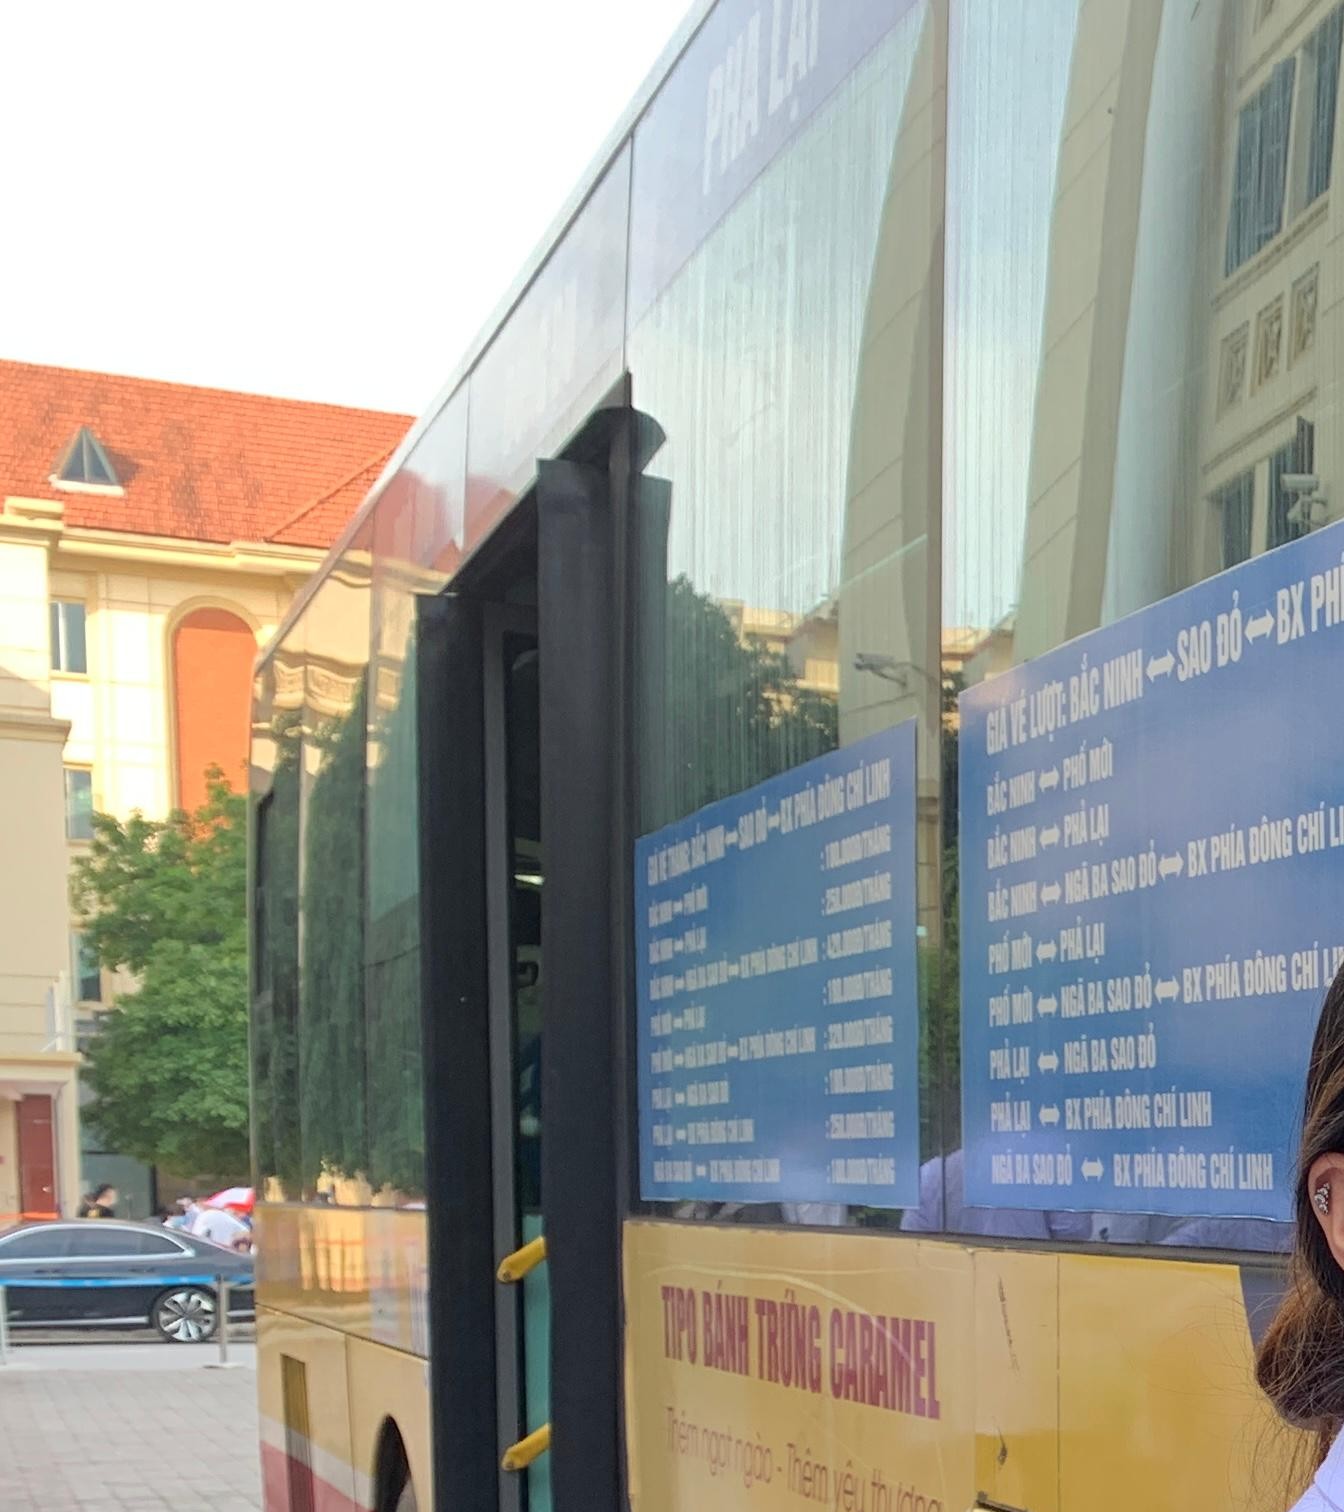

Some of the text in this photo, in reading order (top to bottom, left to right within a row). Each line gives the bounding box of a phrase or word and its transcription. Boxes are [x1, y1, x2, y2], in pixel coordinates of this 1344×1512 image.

[1103, 649, 1143, 710] NINH
[1177, 621, 1211, 681] SAO
[1216, 590, 1242, 667] ĐỎ
[1277, 582, 1304, 644] BX
[1092, 863, 1109, 898] BA
[1111, 856, 1135, 895] SAO
[1188, 840, 1207, 877] BX
[1211, 824, 1245, 872] PHÍA
[1249, 816, 1292, 864] ĐÔNG
[1297, 802, 1325, 854] CHÍ
[1087, 981, 1104, 1015] BA
[1107, 977, 1131, 1012] SAO
[1183, 967, 1203, 1004] BX
[1206, 954, 1240, 1001] PHÍA
[1244, 950, 1287, 995] ĐÔNG
[1291, 941, 1319, 991] CHÍ
[1065, 1098, 1082, 1130] BX
[1084, 1090, 1112, 1130] PHÍA
[1115, 1088, 1151, 1129] ĐÔNG
[1153, 1086, 1177, 1128] CHÍ
[1180, 1091, 1212, 1128] LINH
[1114, 1145, 1273, 1190] BX PHÍA ĐÔNG CHÍ LINH
[661, 1285, 698, 1365] TIPO
[702, 1279, 750, 1376] BÁNH
[830, 1307, 941, 1421] CARAMEL
[786, 1442, 829, 1505] Thêm
